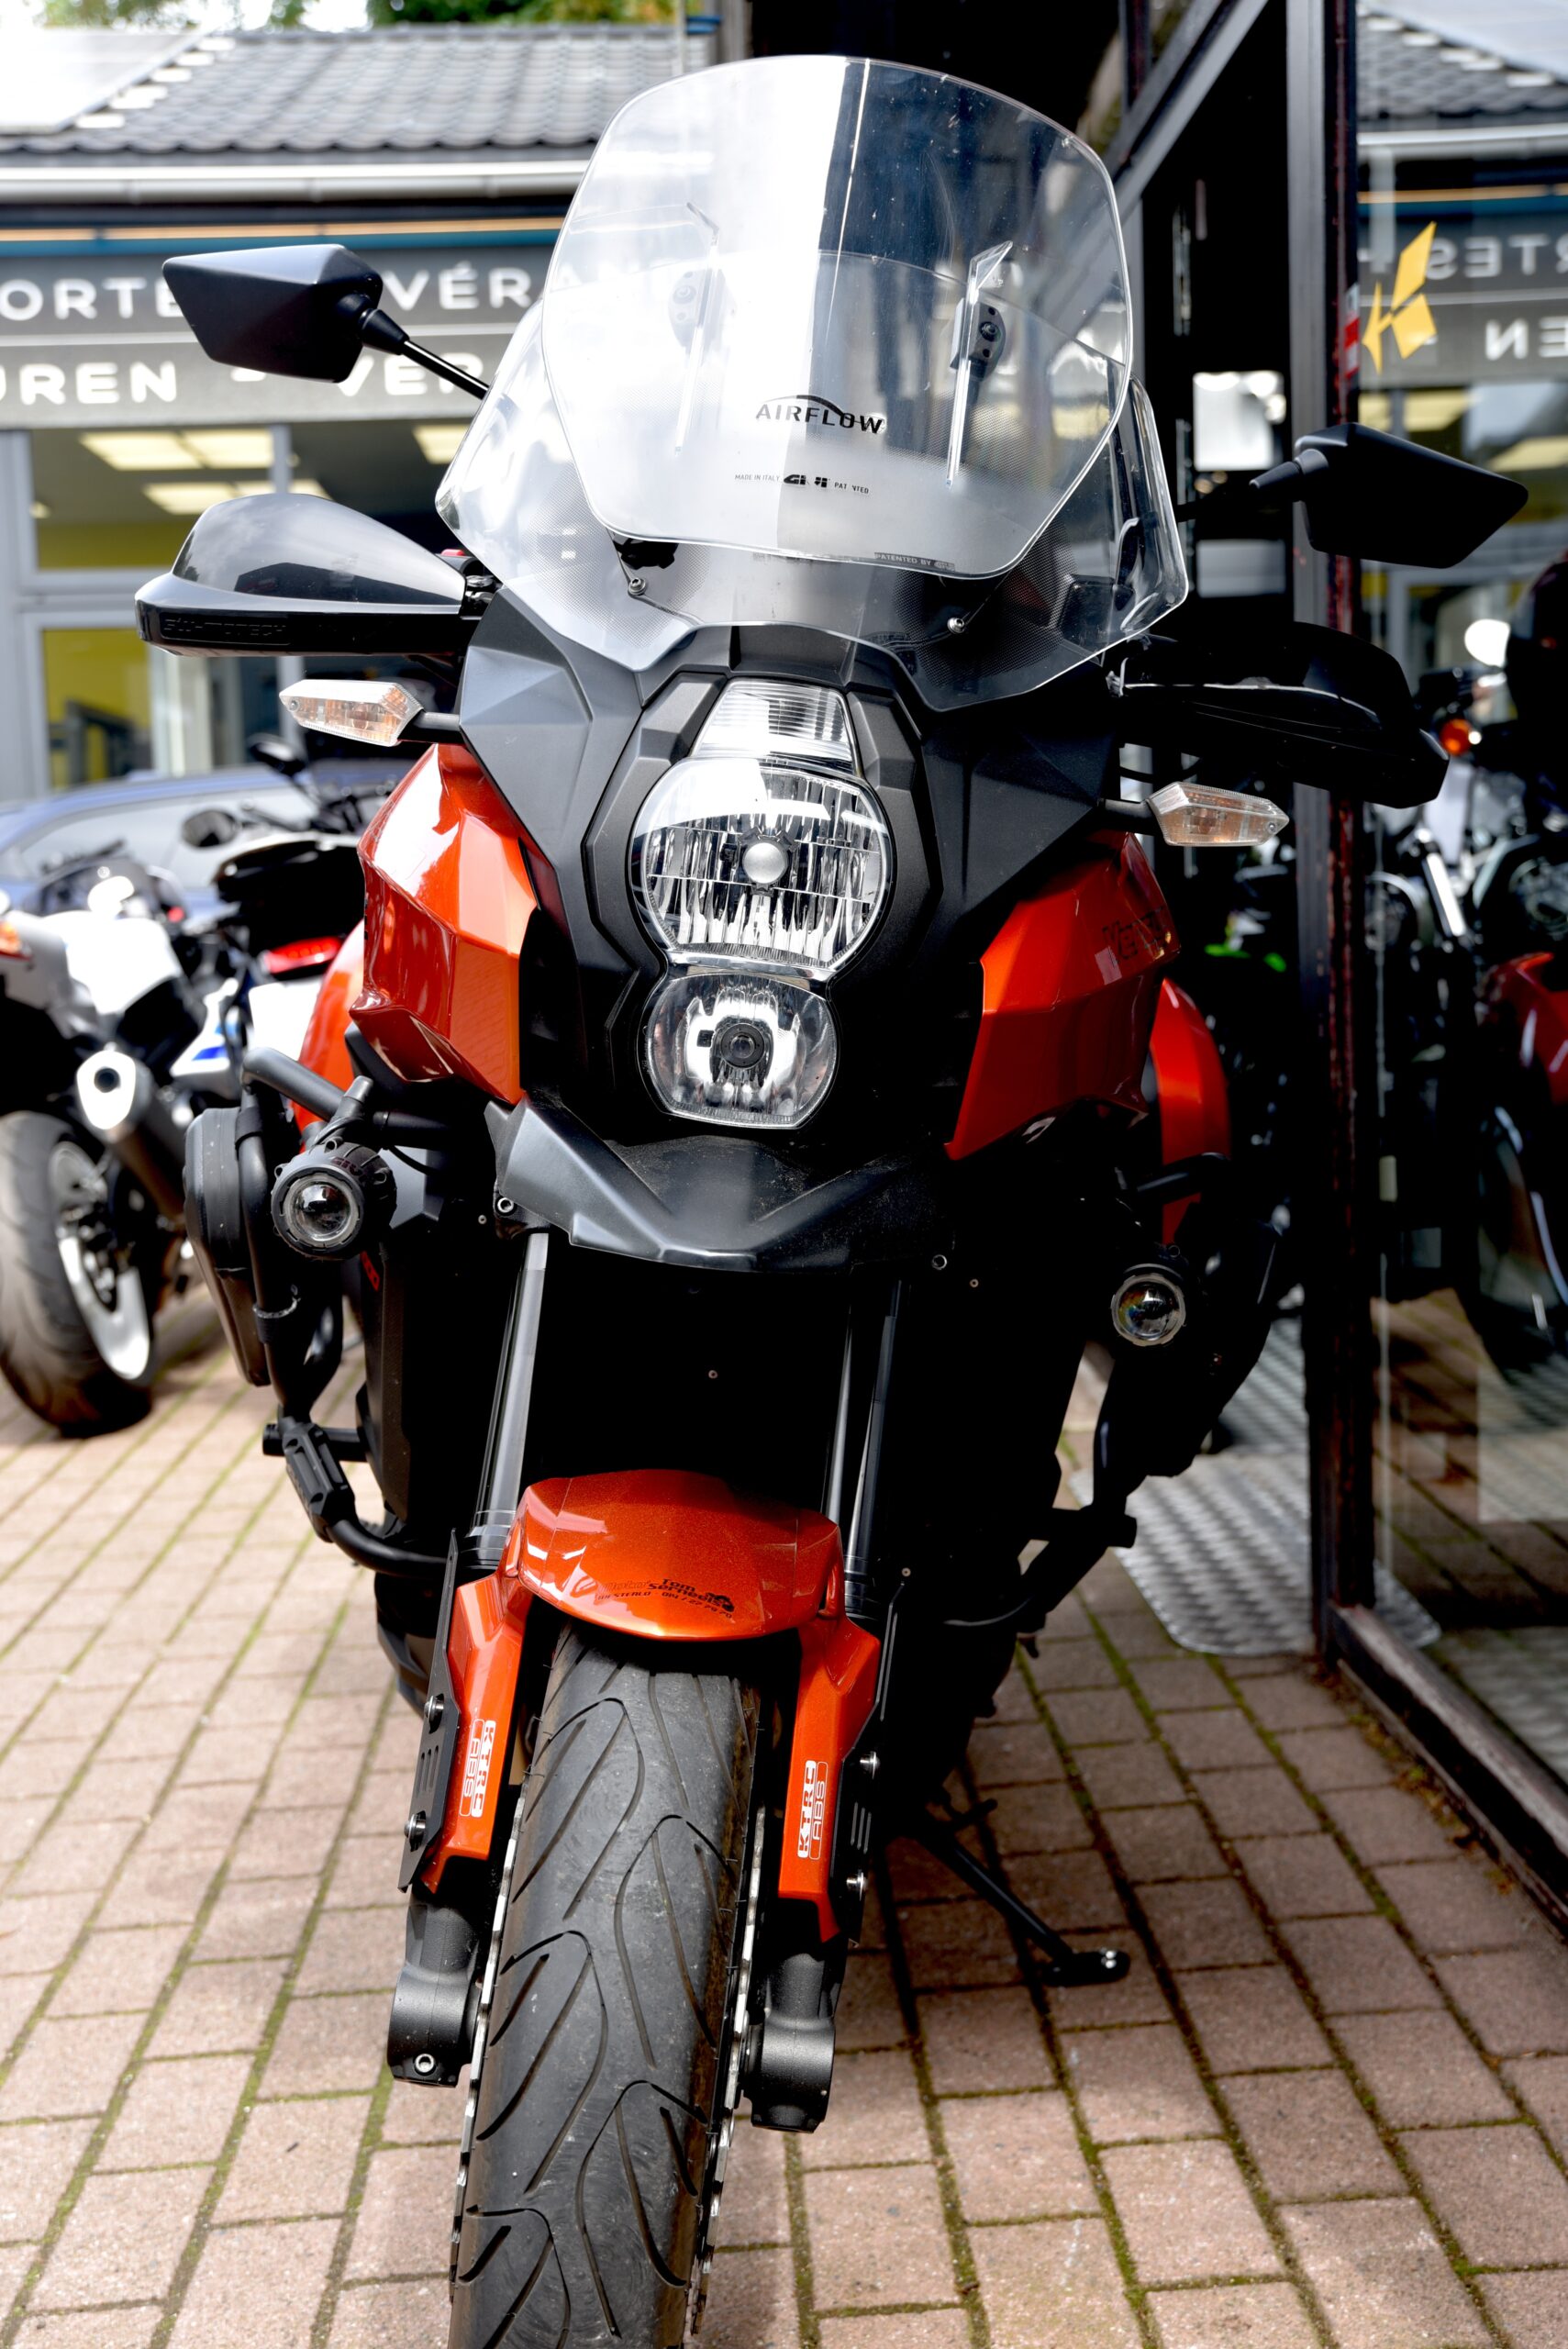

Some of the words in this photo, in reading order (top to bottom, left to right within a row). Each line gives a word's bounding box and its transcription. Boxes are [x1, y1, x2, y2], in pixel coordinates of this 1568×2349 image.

[755, 404, 884, 434] AIRFLOW
[762, 474, 780, 483] ITALY
[834, 482, 870, 495] PATNTED
[874, 552, 917, 564] PATENTED
[920, 558, 931, 566] BY
[662, 1578, 695, 1592] Tom
[463, 1737, 481, 1798] ABS
[473, 1724, 495, 1813] KTRC
[798, 1765, 816, 1853] KTRC
[812, 1780, 825, 1841] ABS
